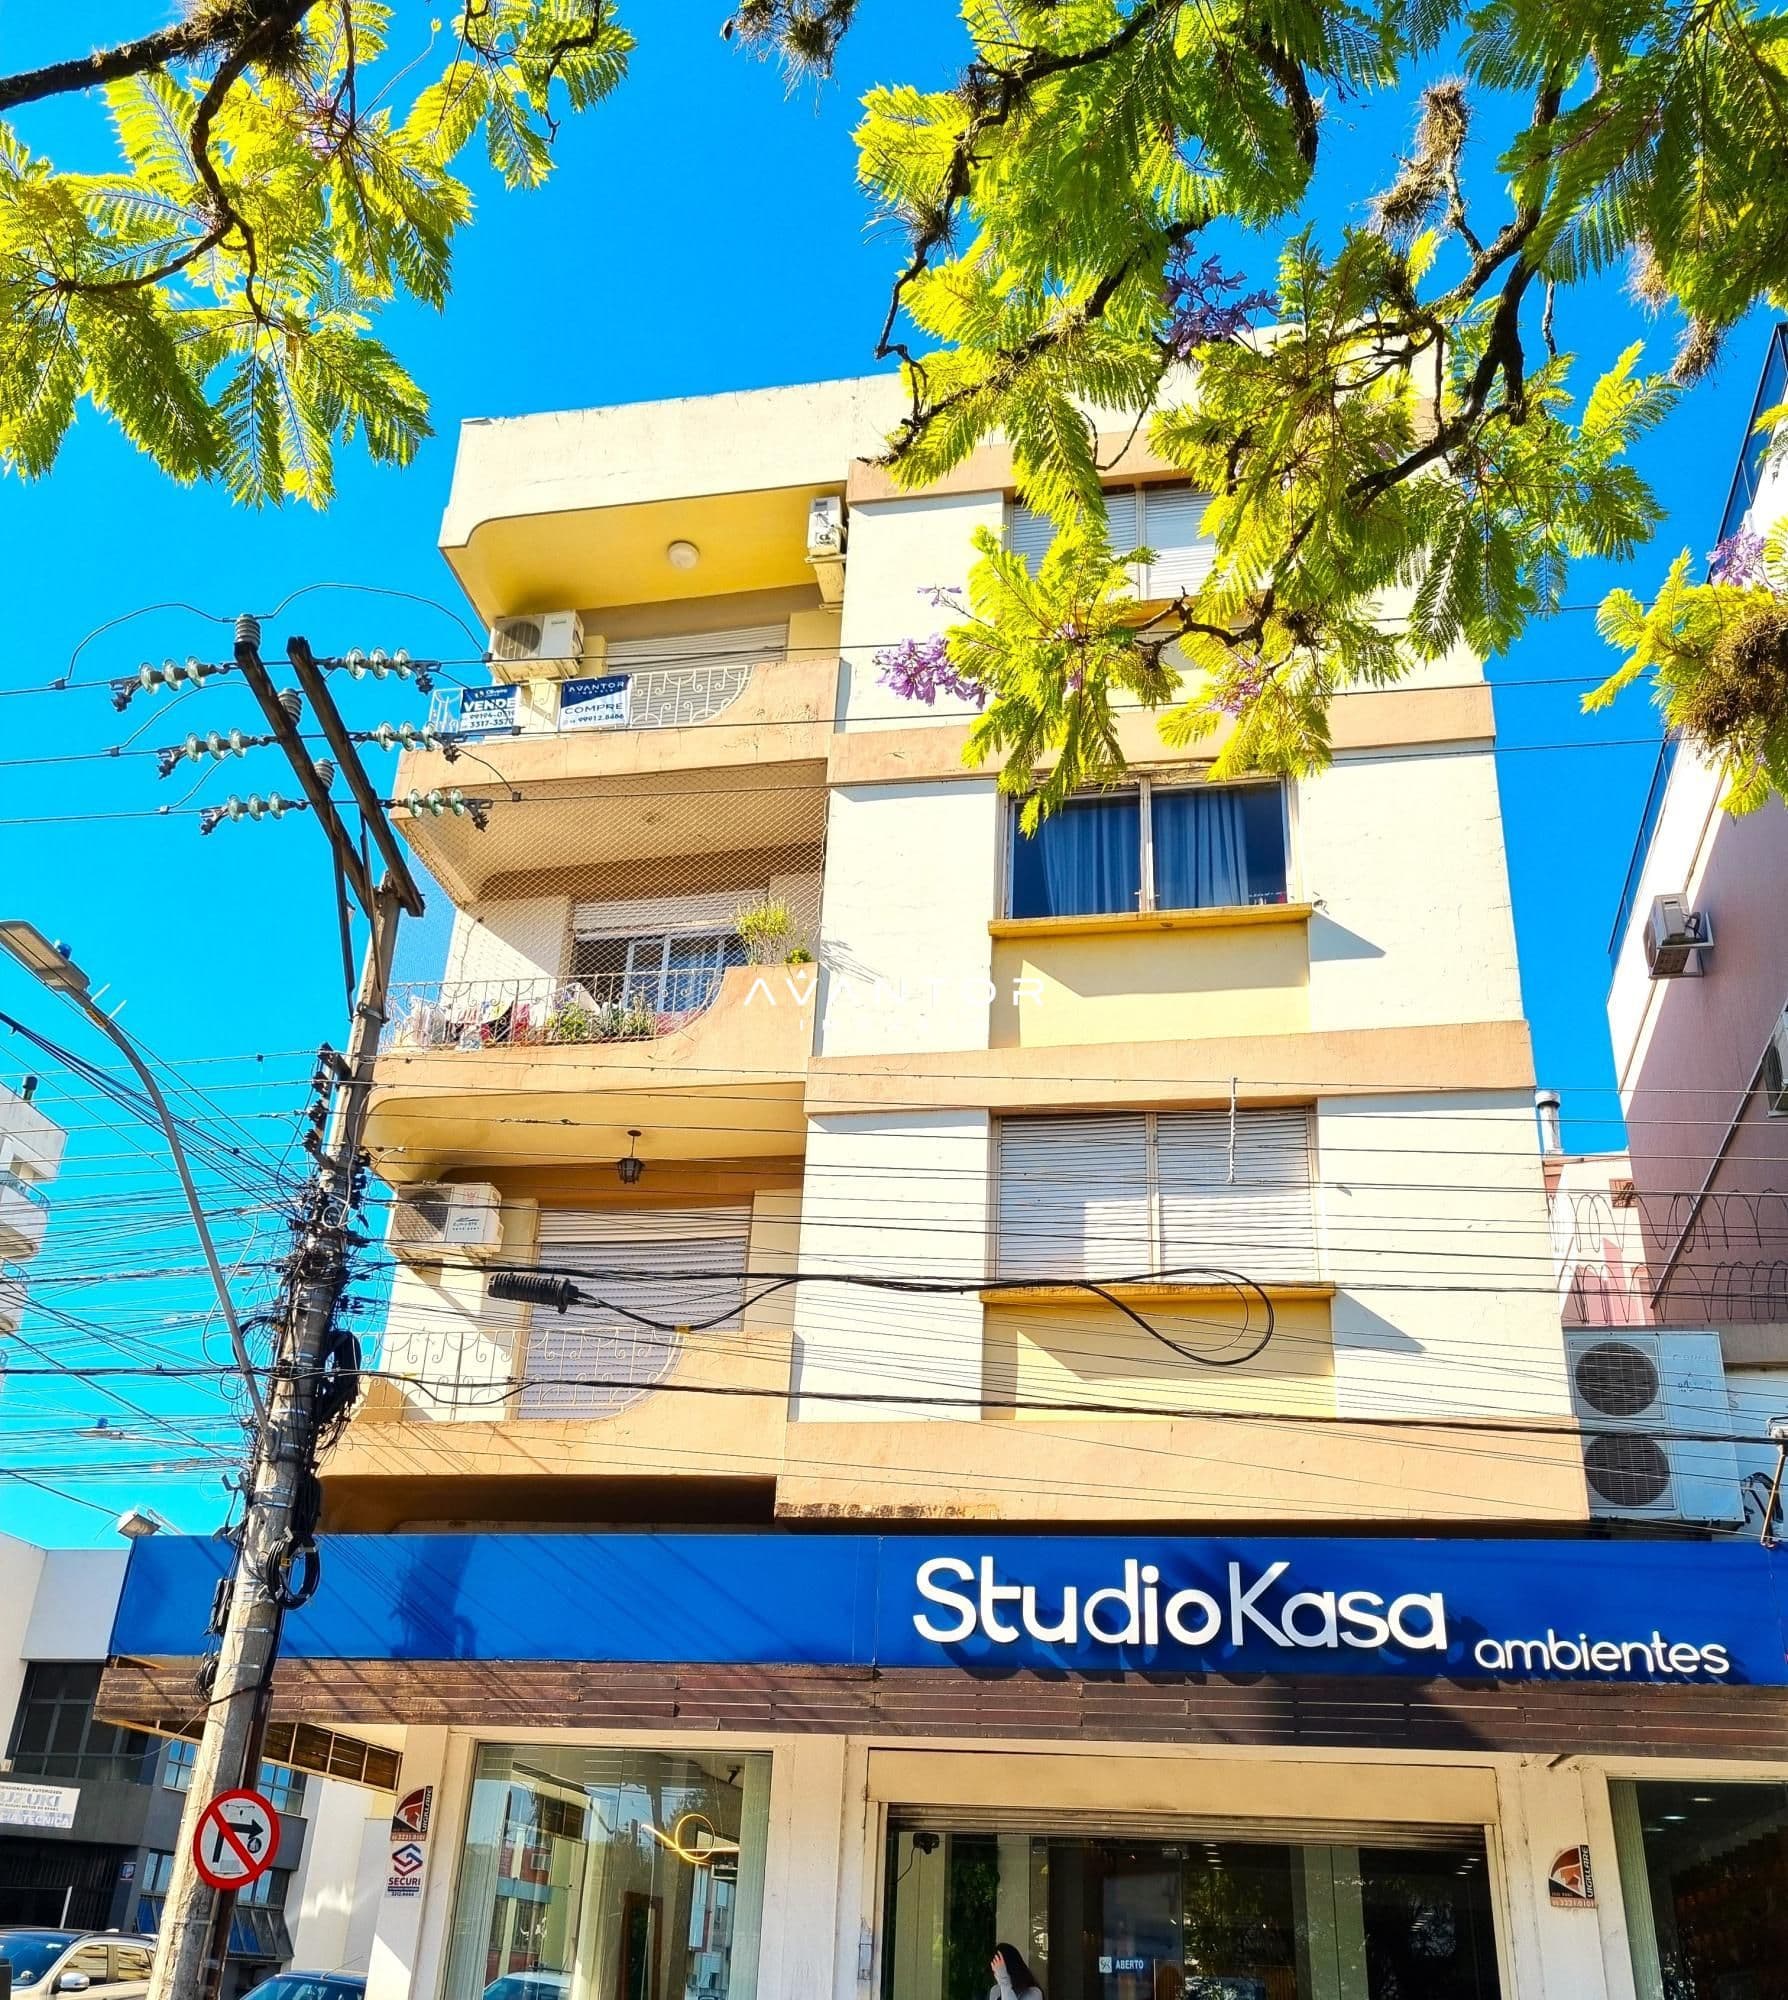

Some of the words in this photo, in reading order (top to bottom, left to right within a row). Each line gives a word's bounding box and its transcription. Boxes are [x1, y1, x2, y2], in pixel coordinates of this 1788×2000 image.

[569, 681, 625, 693] AVANTOR
[463, 697, 516, 712] VENDE
[564, 702, 625, 715] COMPRE
[1474, 1628, 1730, 1674] ambientes
[0, 1791, 61, 1807] UZUKI
[388, 1877, 421, 1886] SECURI
[1115, 1959, 1144, 1970] ABERTO
